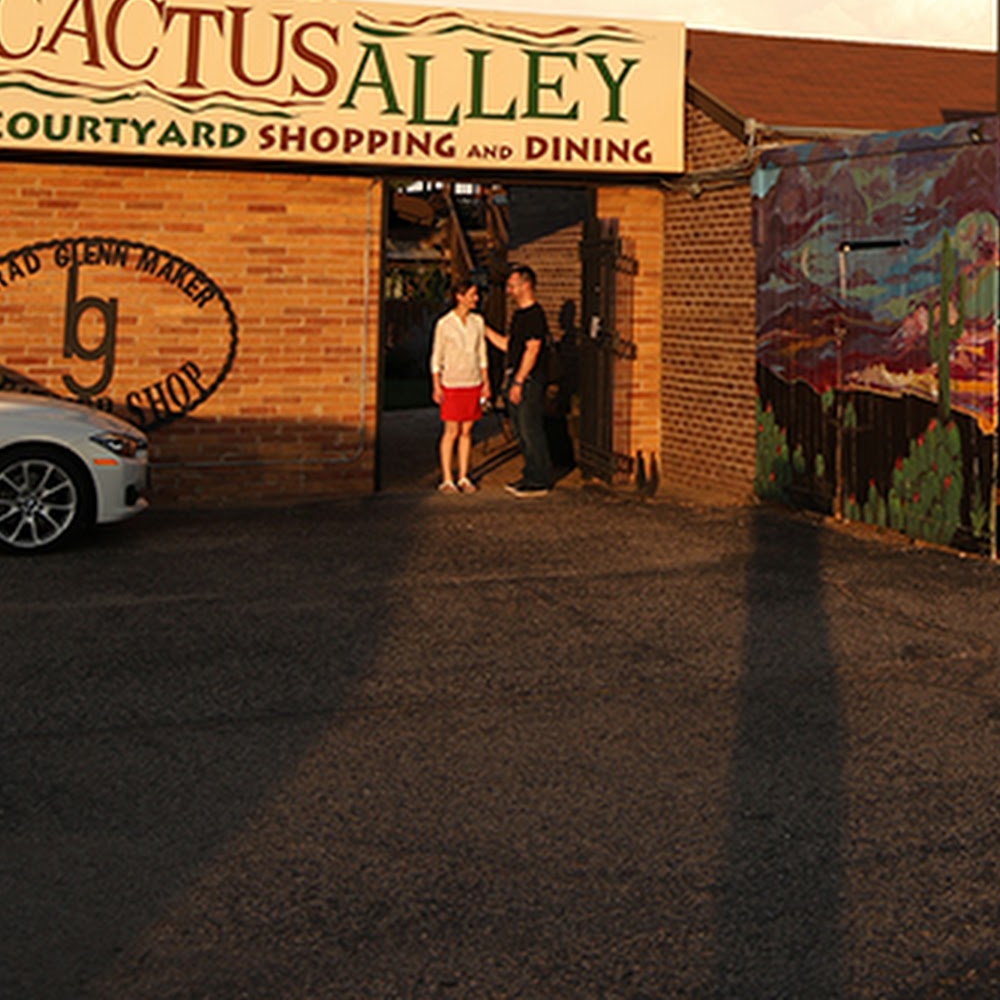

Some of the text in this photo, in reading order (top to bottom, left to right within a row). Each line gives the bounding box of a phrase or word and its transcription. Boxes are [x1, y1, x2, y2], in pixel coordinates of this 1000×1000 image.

[339, 42, 640, 127] ALLEY
[0, 111, 652, 164] OURTYARD SHOPPING AND DINING
[0, 244, 215, 308] AD GLENN MAKER
[126, 360, 203, 425] SHOP
